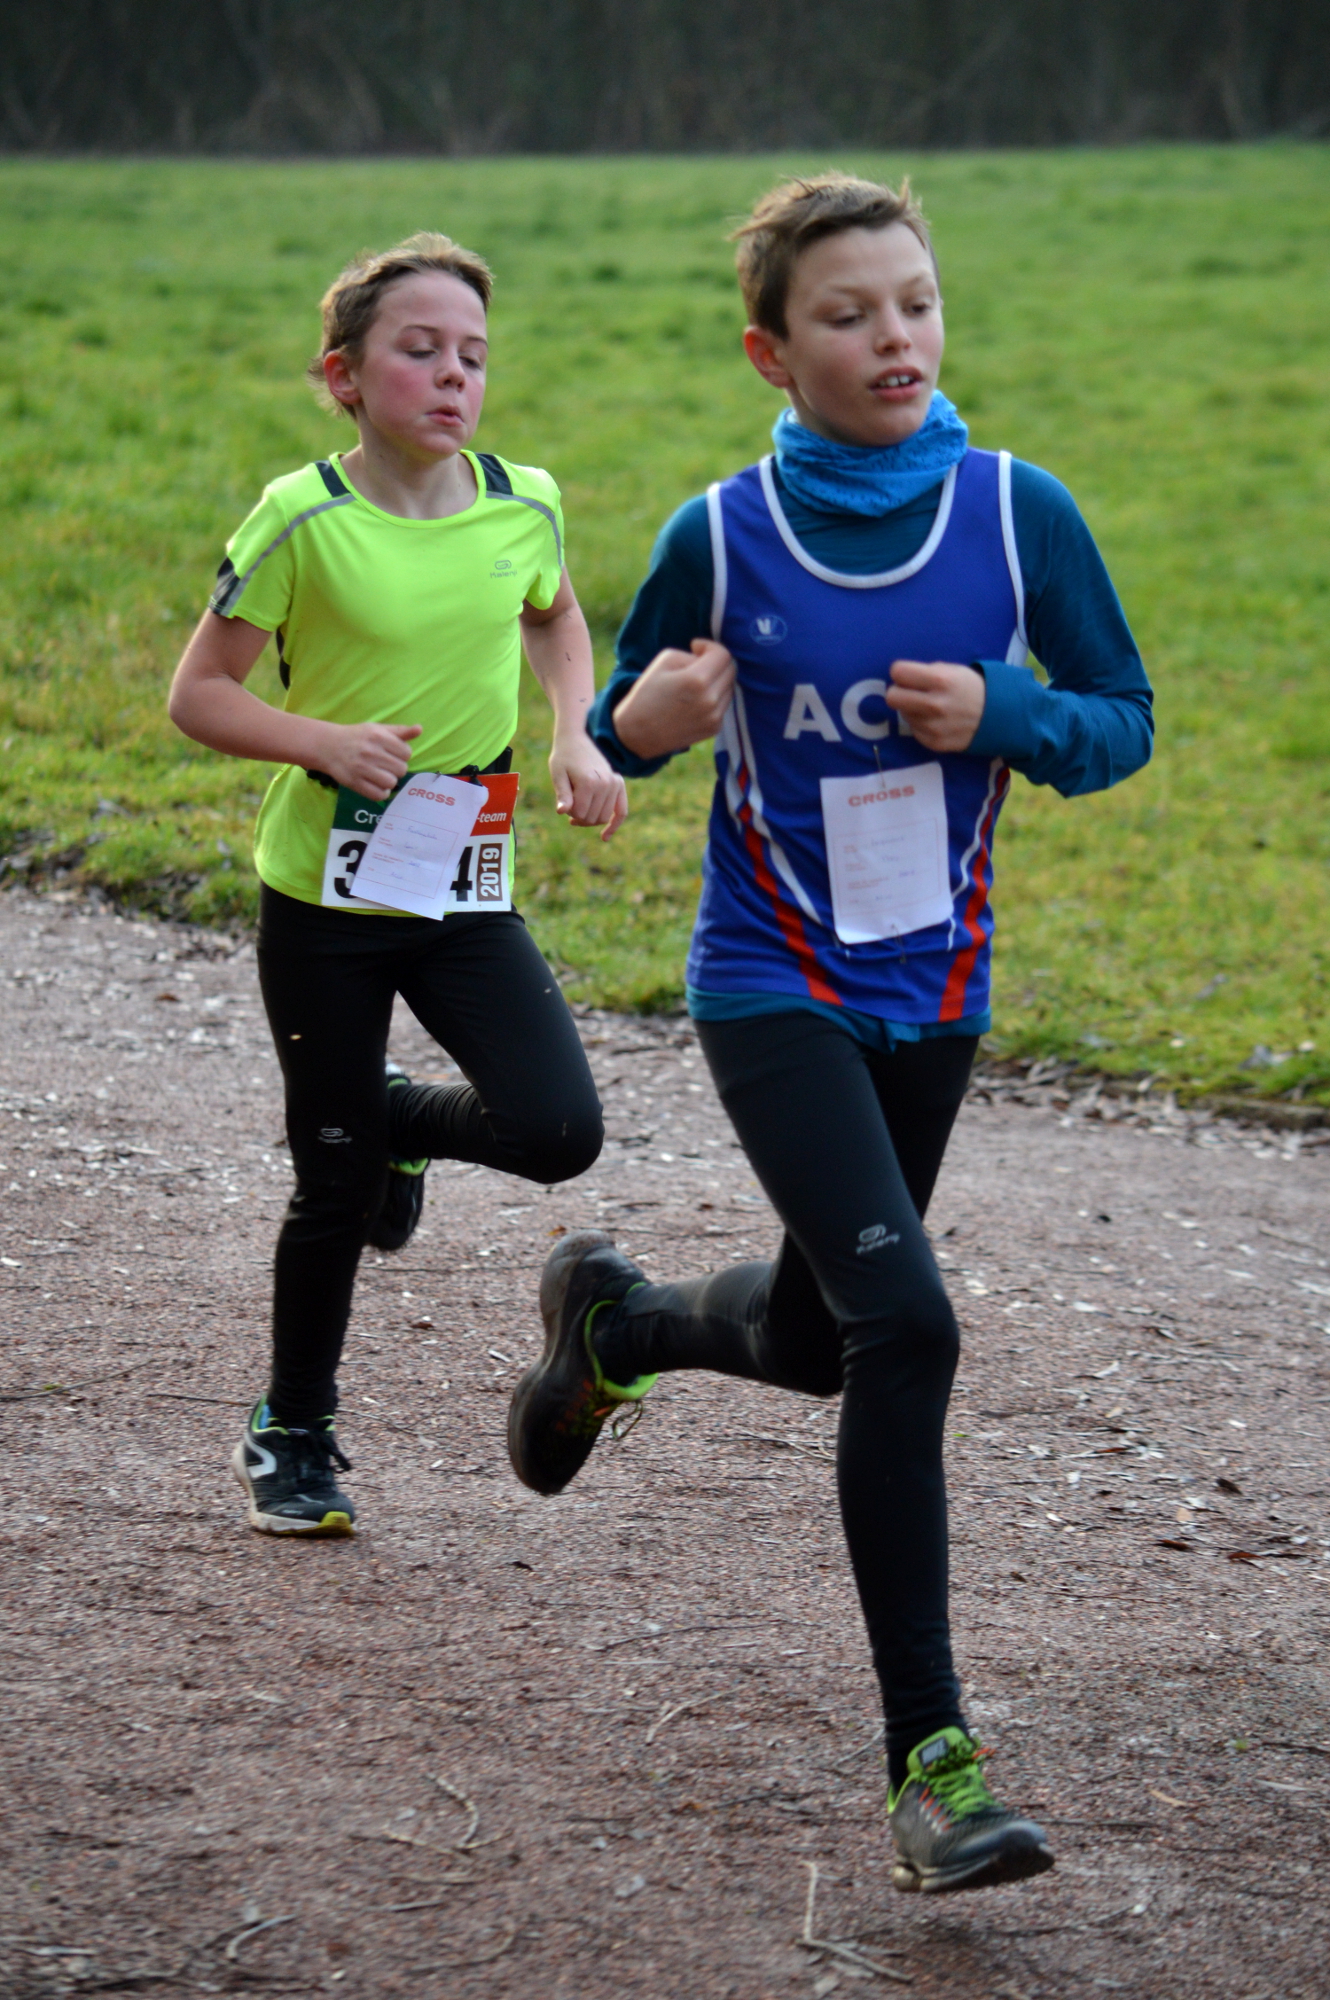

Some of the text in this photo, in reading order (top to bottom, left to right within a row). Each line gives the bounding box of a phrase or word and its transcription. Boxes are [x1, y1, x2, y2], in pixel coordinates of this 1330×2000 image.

[783, 679, 914, 742] AC
[407, 788, 456, 806] CROSS
[848, 785, 915, 807] CROSS
[481, 848, 500, 897] 2019
